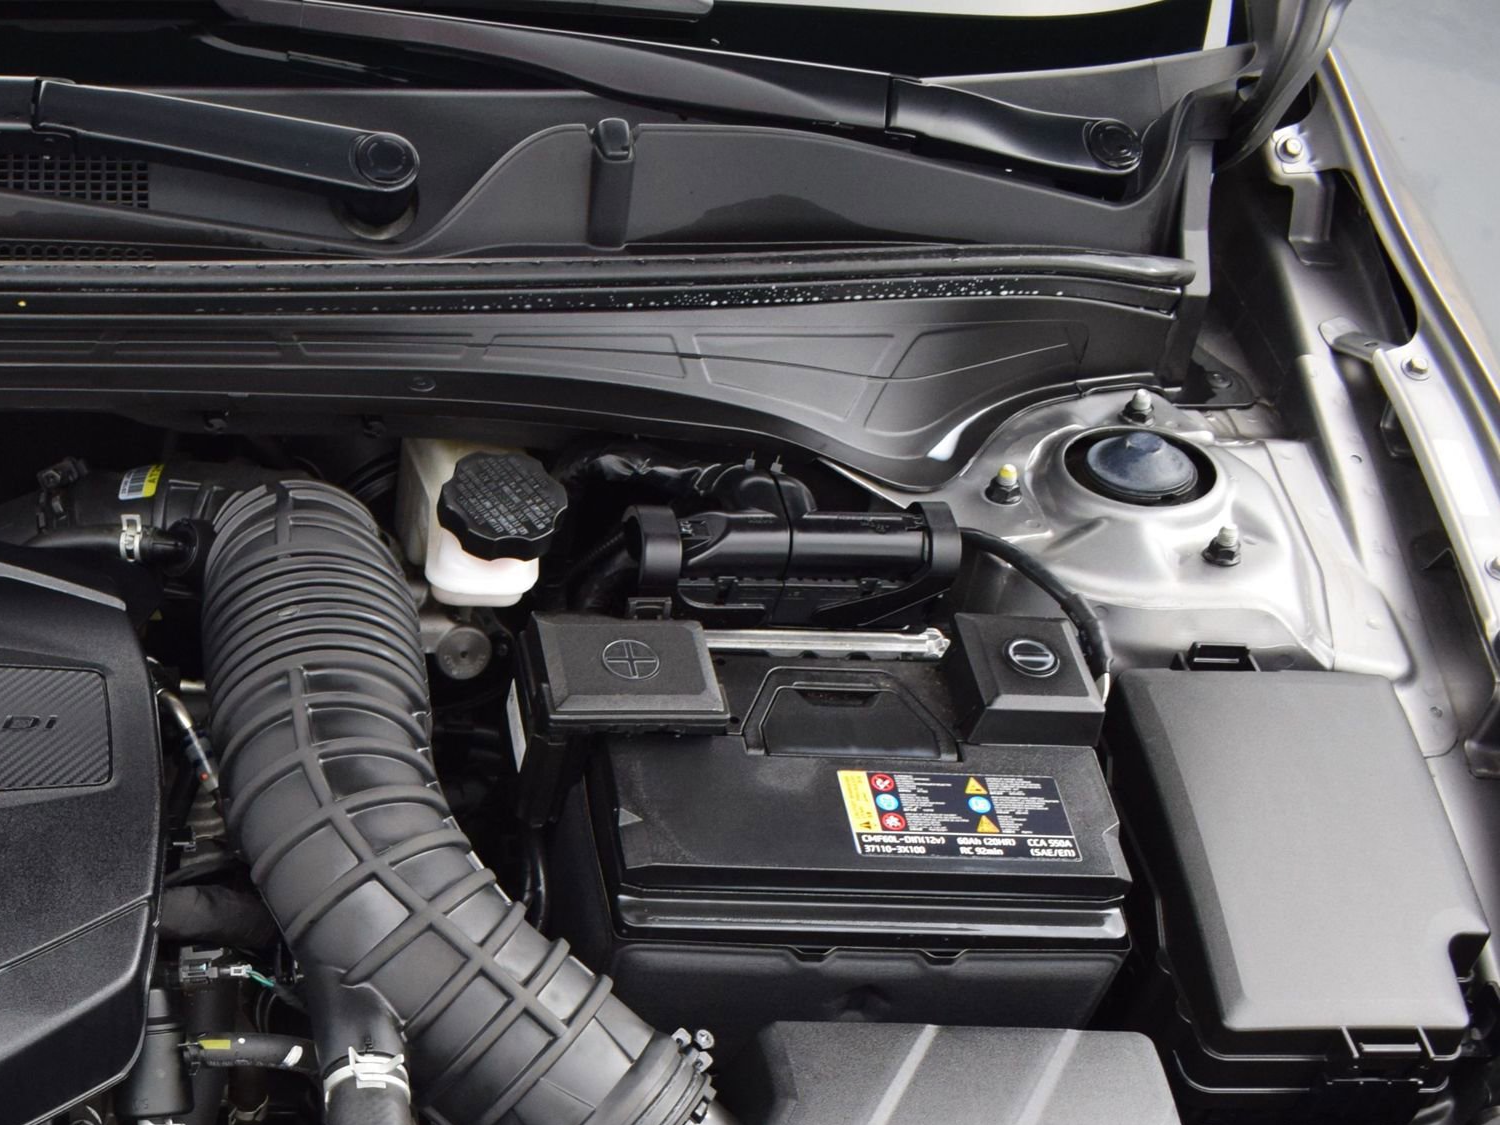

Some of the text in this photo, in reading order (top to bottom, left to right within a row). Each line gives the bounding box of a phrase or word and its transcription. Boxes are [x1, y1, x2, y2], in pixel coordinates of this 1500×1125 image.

[956, 837, 981, 846] 60Ah
[1027, 839, 1047, 848] CCA
[1049, 839, 1073, 848] 550A
[960, 847, 974, 855] RC
[975, 847, 1004, 856] 92min
